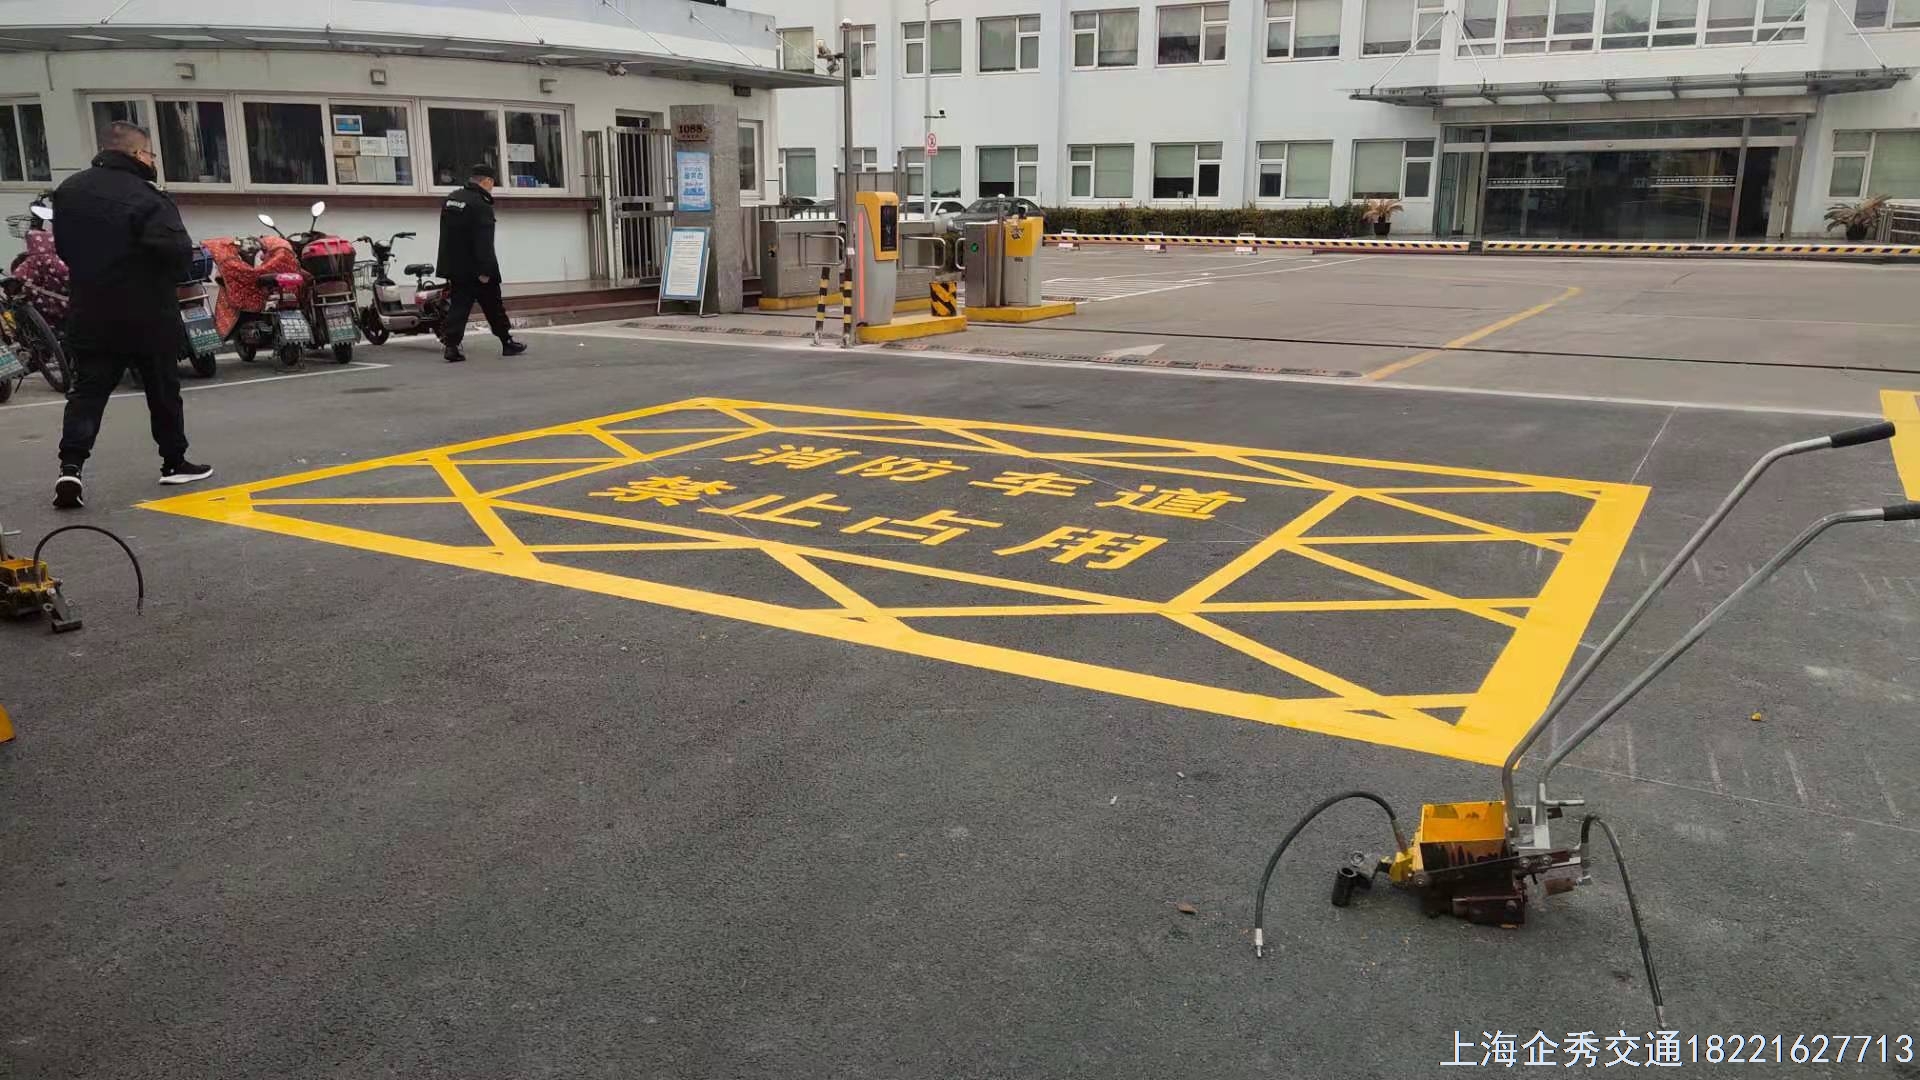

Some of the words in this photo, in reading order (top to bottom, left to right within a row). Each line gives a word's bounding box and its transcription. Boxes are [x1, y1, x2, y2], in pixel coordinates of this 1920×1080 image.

[679, 124, 703, 134] 1088
[720, 443, 1246, 521] 消防车道
[588, 475, 1168, 571] 禁止占用
